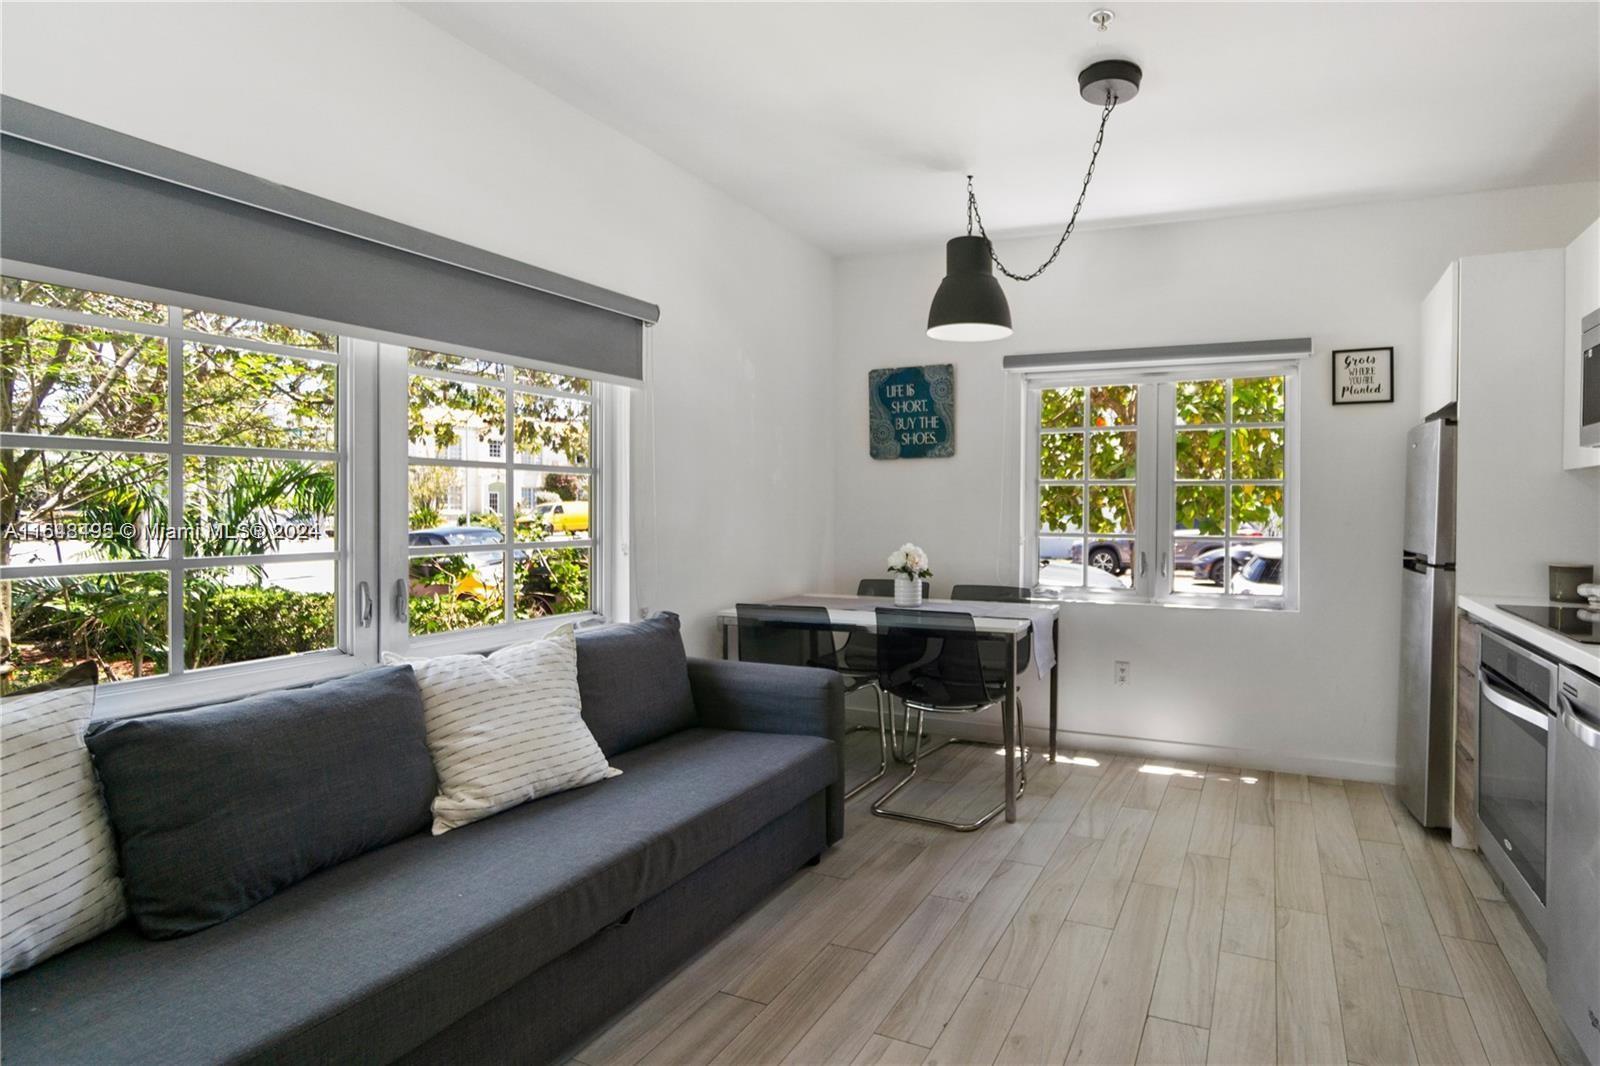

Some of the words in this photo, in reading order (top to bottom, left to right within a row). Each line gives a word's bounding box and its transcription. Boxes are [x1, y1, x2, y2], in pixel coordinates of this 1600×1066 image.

[886, 384, 904, 398] LIFE
[906, 383, 916, 397] IS
[891, 399, 929, 414] SHORT.
[895, 417, 917, 431] BUY
[920, 415, 940, 429] THE
